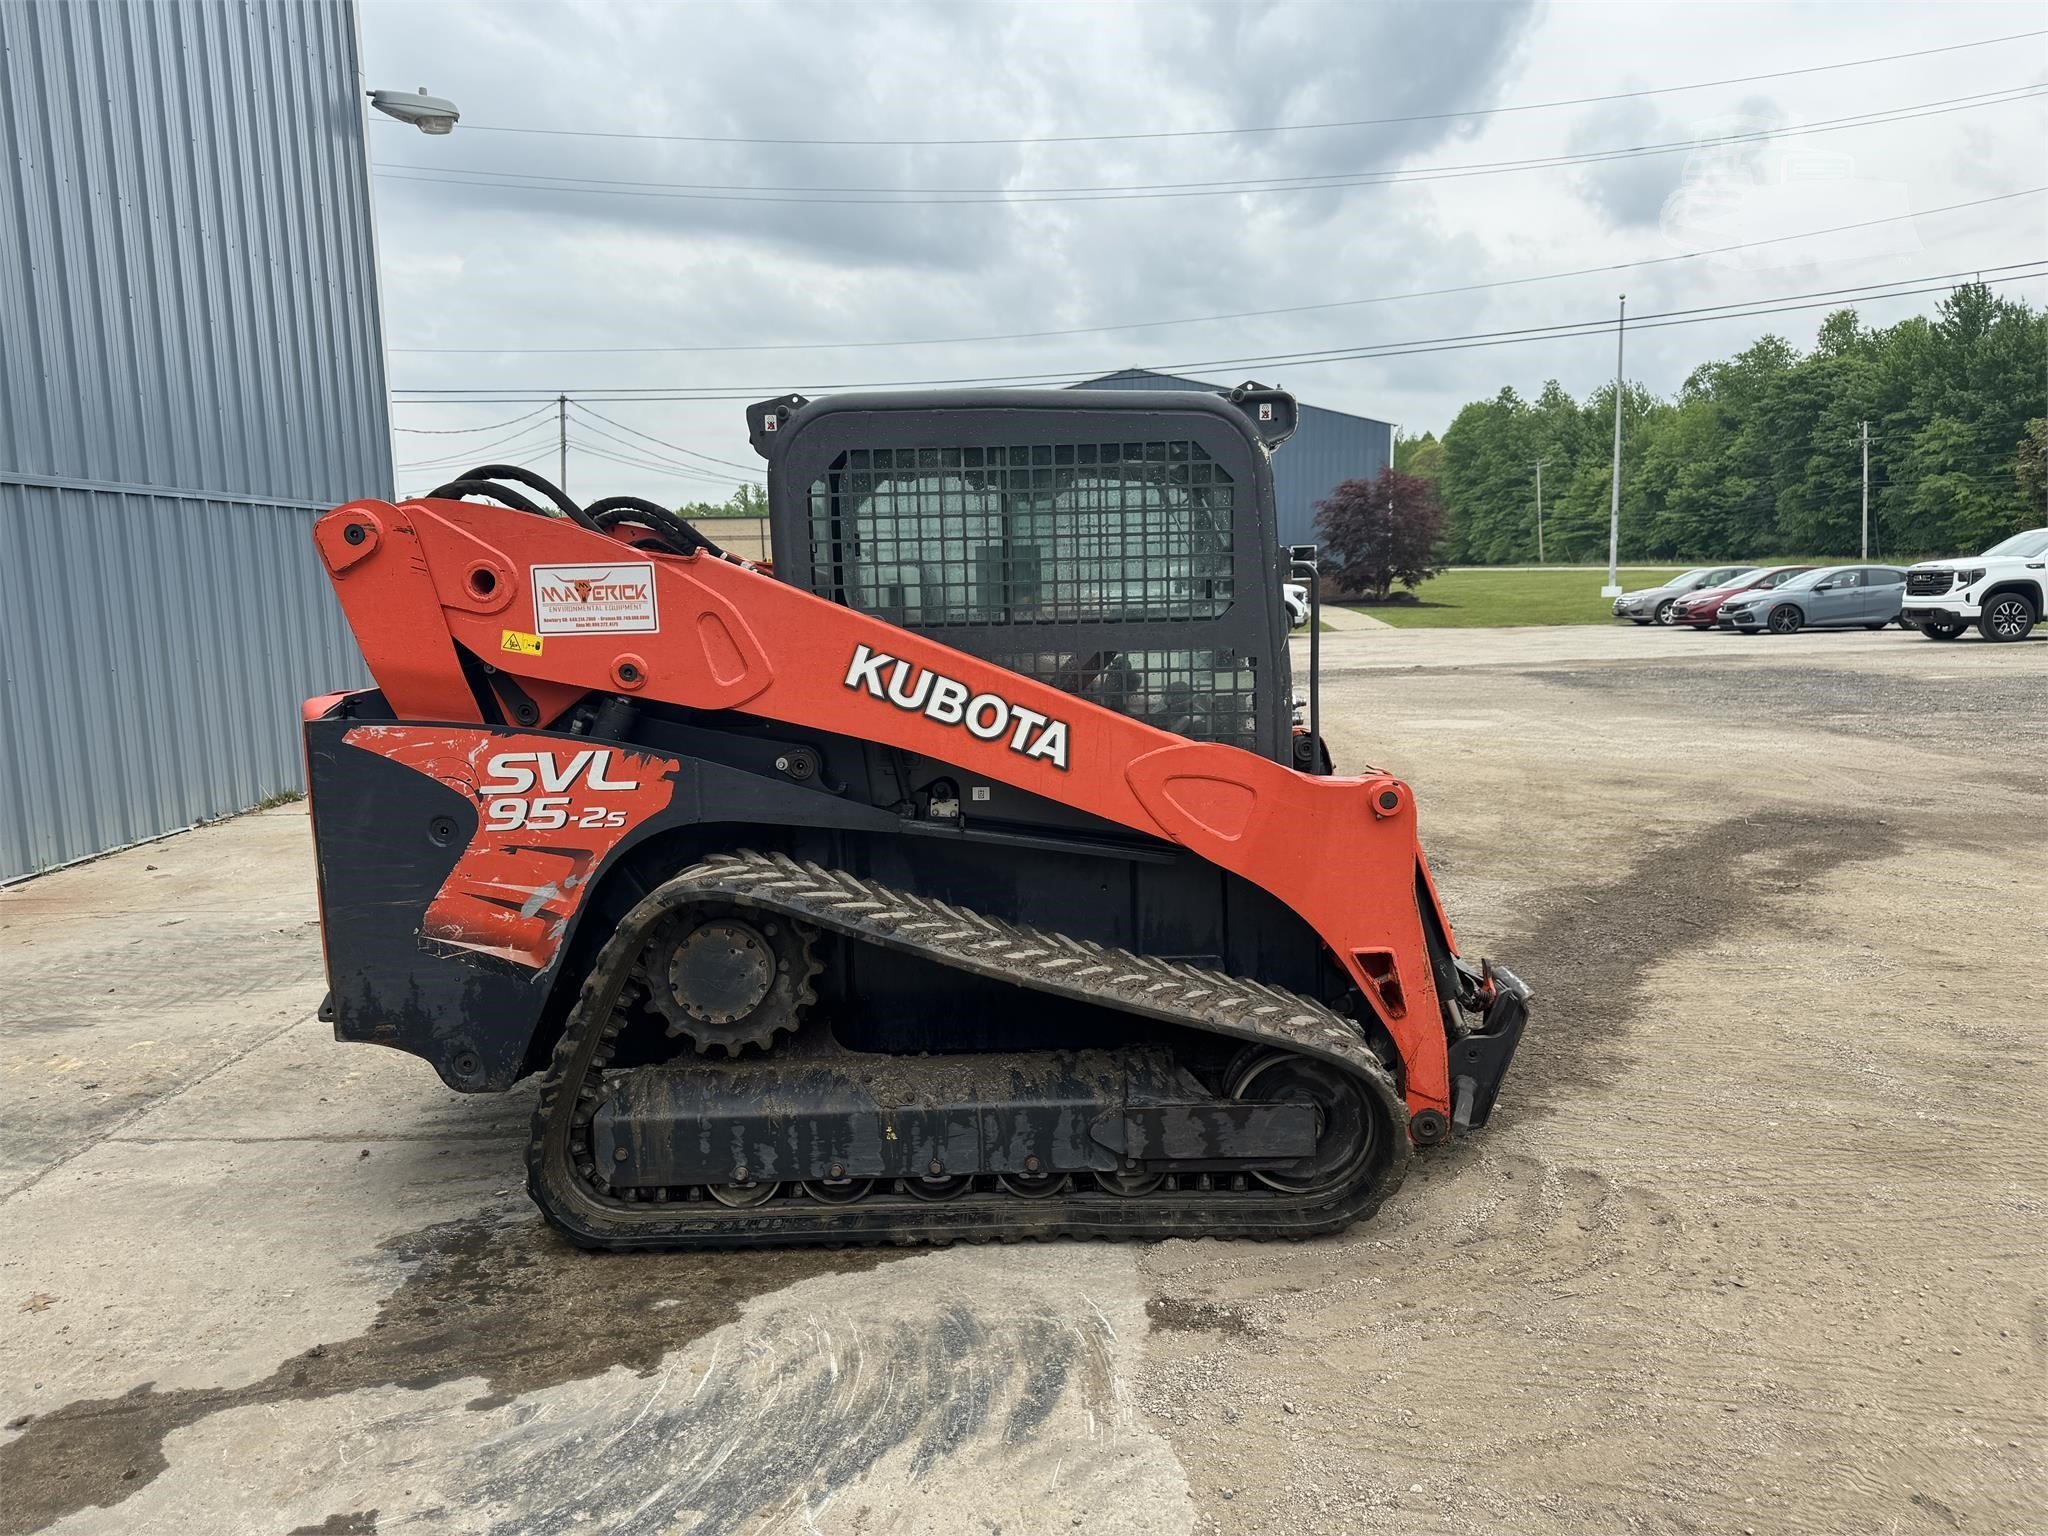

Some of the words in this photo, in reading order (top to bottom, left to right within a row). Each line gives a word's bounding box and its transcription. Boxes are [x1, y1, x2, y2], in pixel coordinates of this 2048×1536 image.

[541, 583, 648, 602] MAVERICK
[548, 605, 603, 613] ENVIRONMENTAL
[605, 603, 643, 611] EQUIPMENT
[844, 643, 1070, 771] KUBOTA
[479, 749, 641, 795] SVL
